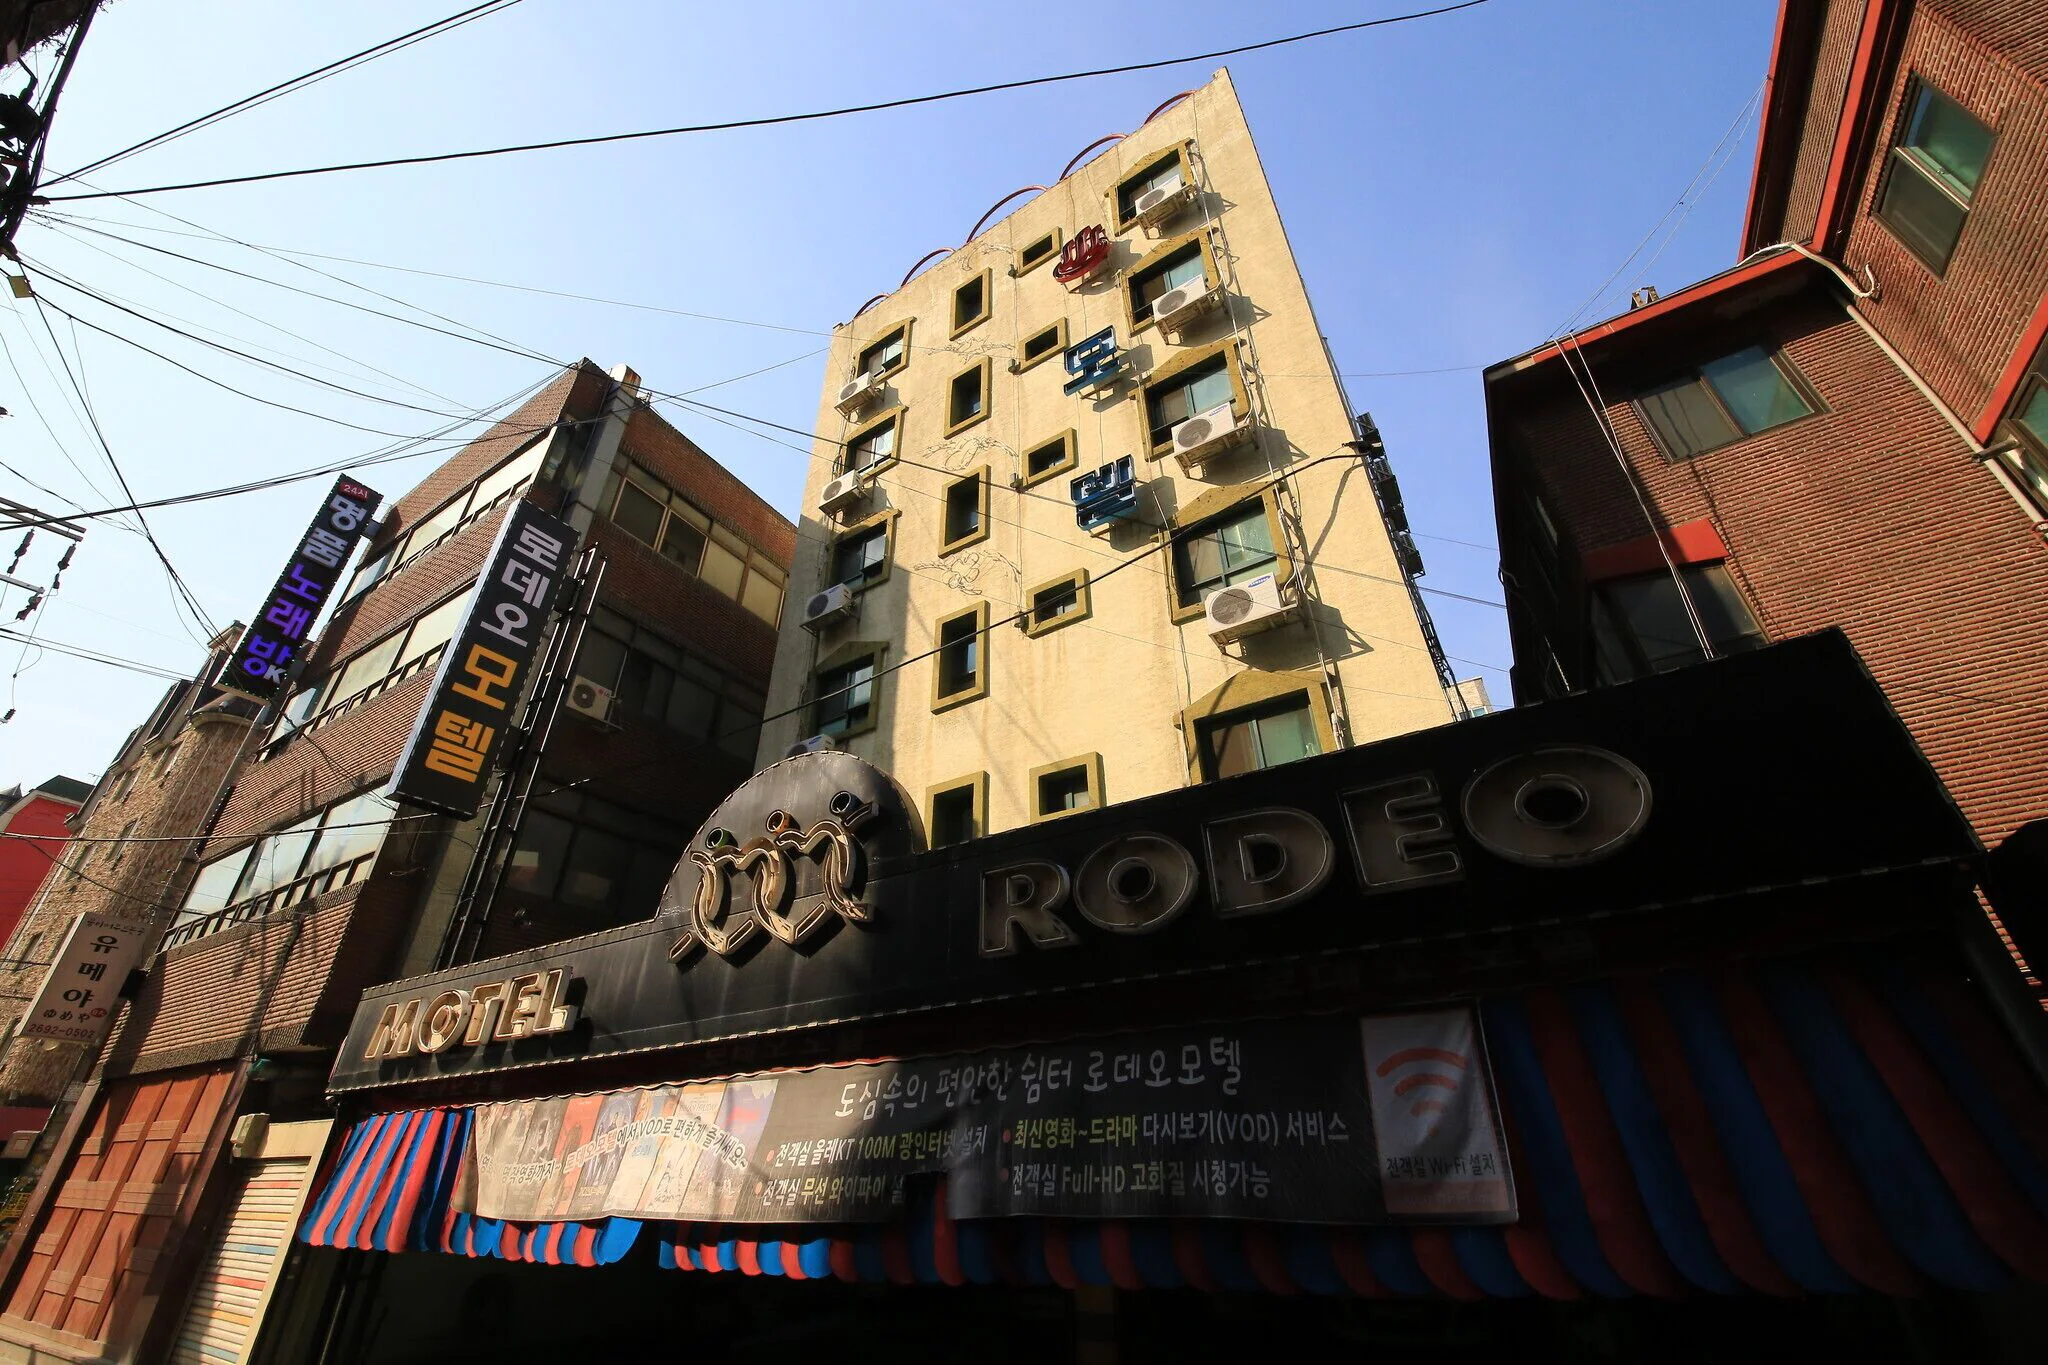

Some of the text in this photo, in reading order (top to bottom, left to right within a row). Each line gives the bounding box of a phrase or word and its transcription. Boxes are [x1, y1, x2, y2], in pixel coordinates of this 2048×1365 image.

[344, 484, 368, 498] 24시
[425, 644, 518, 783] 모텔
[978, 742, 1653, 959] RODEO
[62, 935, 119, 1008] 유메야
[364, 967, 574, 1059] MOTEL
[835, 1072, 927, 1120] 도심속의
[935, 1056, 1011, 1108] 편안한
[1020, 1052, 1072, 1104] 쉼터
[674, 1117, 708, 1143] 편하게
[775, 1143, 814, 1168] 전객실
[857, 1135, 896, 1160] 100M
[899, 1129, 956, 1160] 광인터넷
[961, 1124, 987, 1156] 설치
[1143, 1109, 1279, 1146] 다시보기(VOD)
[1285, 1110, 1350, 1147] 서비스
[1012, 1159, 1271, 1199] 전객실 Full-HD 고화질 시청가능
[1429, 1157, 1466, 1176] Wi-Fi
[1469, 1153, 1497, 1176] 설치
[762, 1179, 801, 1206] 전객실
[801, 1177, 829, 1206] 무선
[830, 1174, 886, 1205] 와이파이
